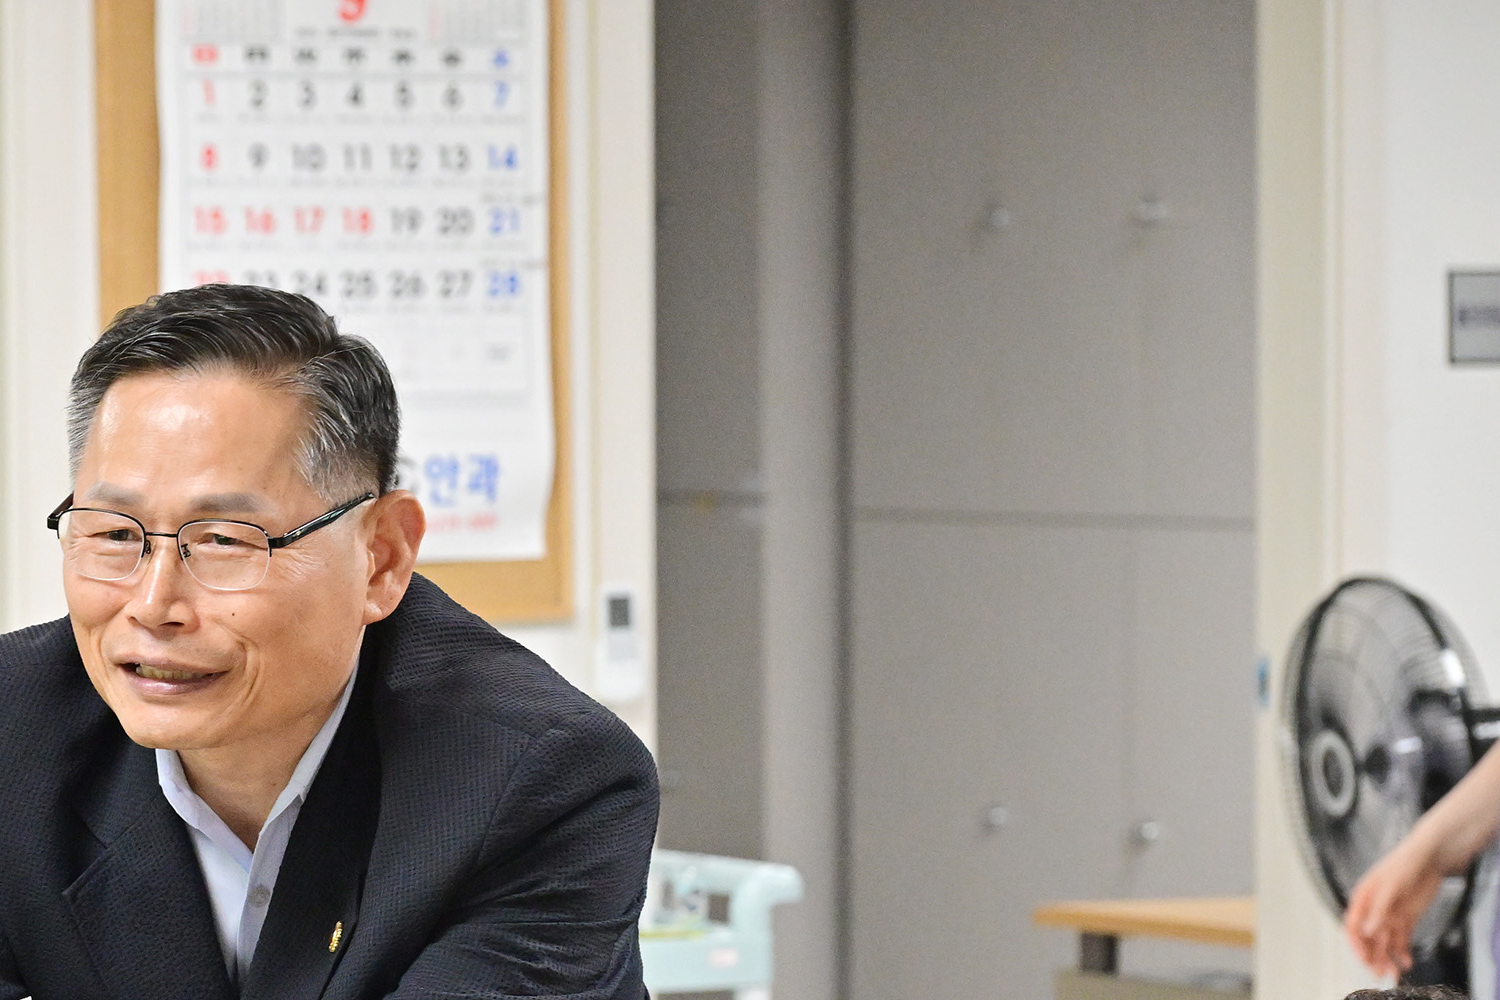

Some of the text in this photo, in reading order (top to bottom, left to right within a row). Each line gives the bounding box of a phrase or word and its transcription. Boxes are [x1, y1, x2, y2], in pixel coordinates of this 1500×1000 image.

[202, 77, 216, 107] 1
[249, 78, 268, 109] 2
[346, 79, 365, 107] 4
[493, 79, 509, 108] 7
[248, 143, 269, 170] 9
[291, 143, 327, 173] 10
[343, 143, 372, 171] 11
[389, 144, 422, 175] 12
[438, 144, 471, 174] 13
[488, 146, 518, 170] 14
[195, 205, 520, 236] 15 16 17 18 19 20 21
[341, 270, 377, 299] 25
[390, 270, 426, 299] 26
[438, 269, 473, 299] 27
[488, 270, 521, 298] 28
